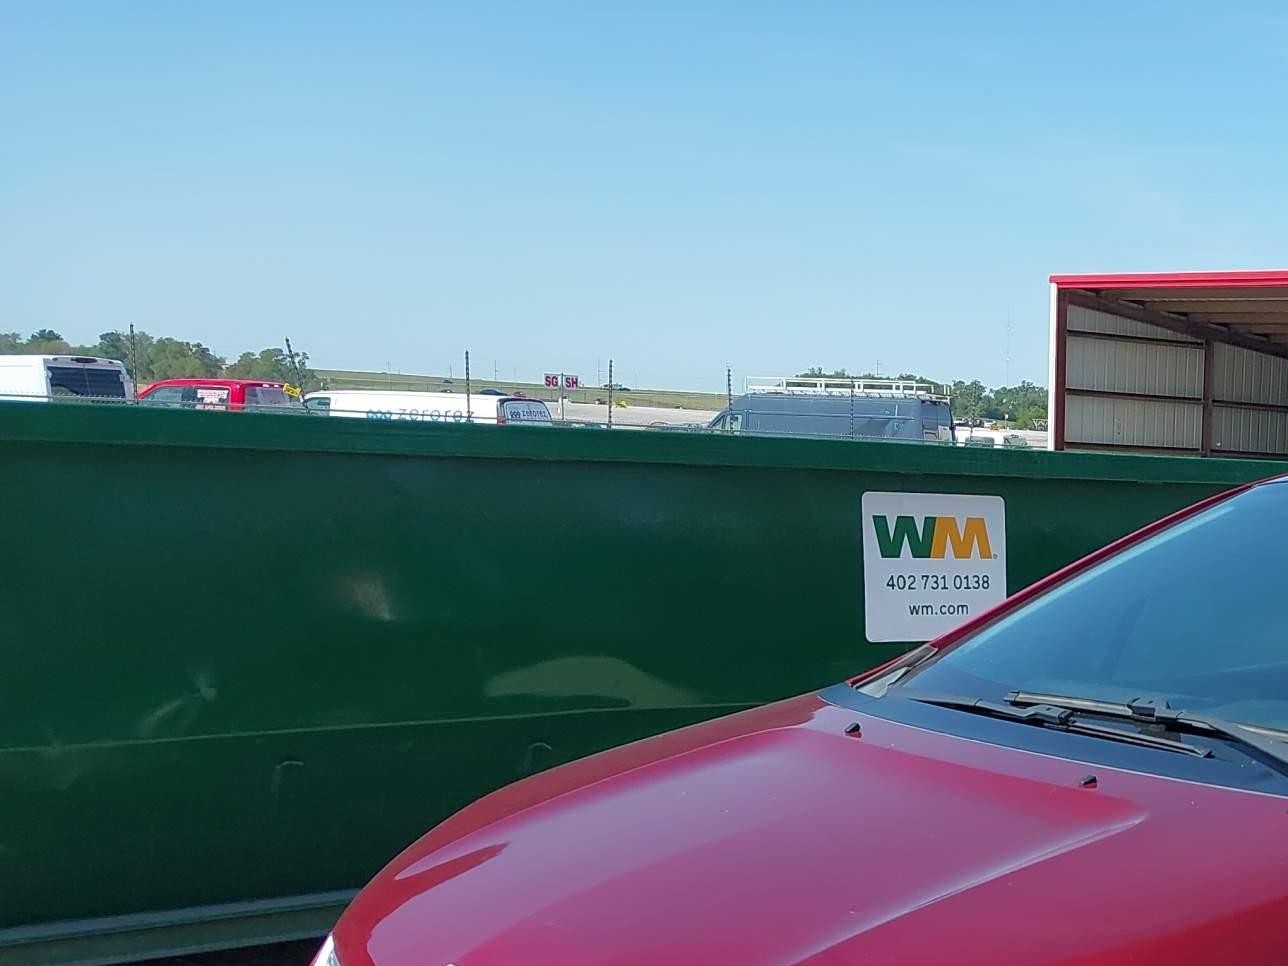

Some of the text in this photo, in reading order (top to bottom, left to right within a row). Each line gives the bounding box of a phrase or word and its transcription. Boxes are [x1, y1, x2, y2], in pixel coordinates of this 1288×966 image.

[545, 376, 578, 388] SG SH
[872, 515, 992, 559] WM
[886, 575, 990, 591] 402 731 0138
[908, 604, 969, 616] wm.com
